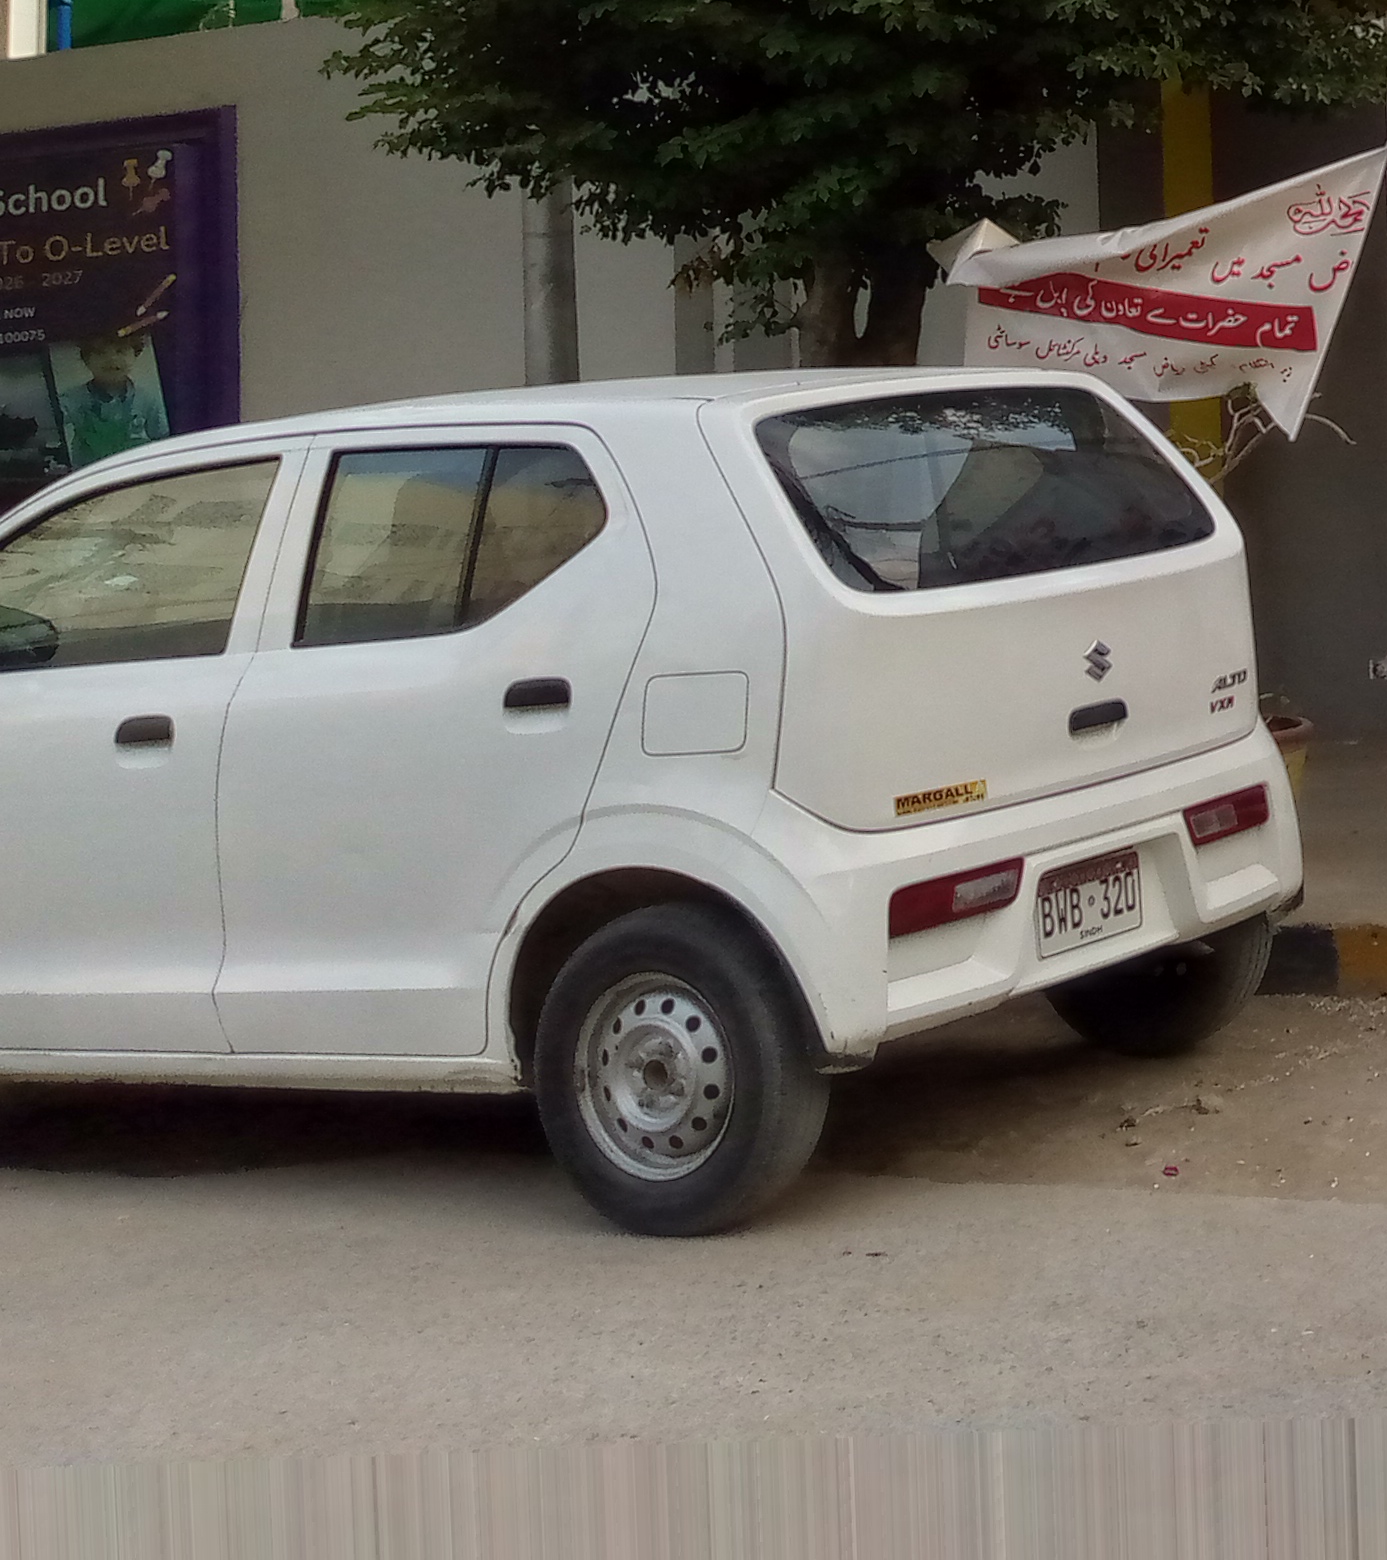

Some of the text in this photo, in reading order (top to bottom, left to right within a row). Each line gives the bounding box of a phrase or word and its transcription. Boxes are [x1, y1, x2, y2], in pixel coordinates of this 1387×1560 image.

[44, 225, 171, 261] O-Level
[41, 269, 83, 288] 2027
[3, 306, 36, 319] NOW
[1178, 307, 1248, 338] حضرات
[1256, 314, 1299, 348] تمام
[1041, 888, 1083, 938] BWB
[1099, 872, 1136, 920] 320
[1080, 925, 1103, 940] SINDH
